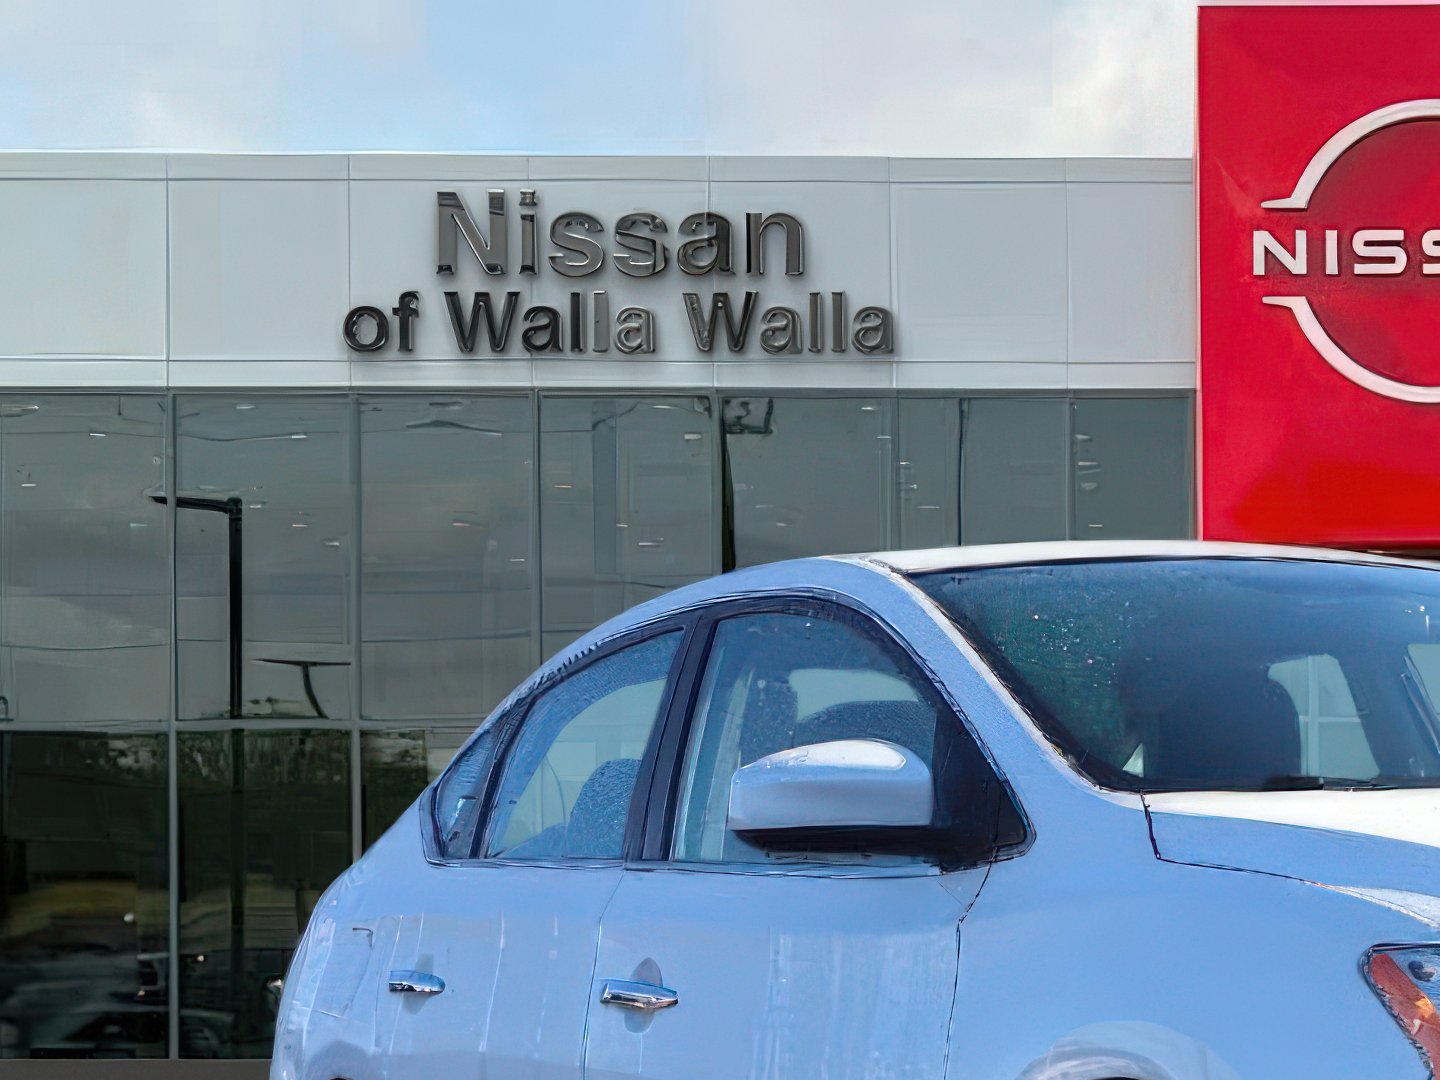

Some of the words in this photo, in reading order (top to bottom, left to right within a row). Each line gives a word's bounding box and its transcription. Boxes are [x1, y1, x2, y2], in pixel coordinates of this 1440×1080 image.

[435, 188, 806, 277] Nissan
[342, 290, 420, 354] of
[443, 290, 657, 355] Walla
[682, 290, 895, 355] Walla
